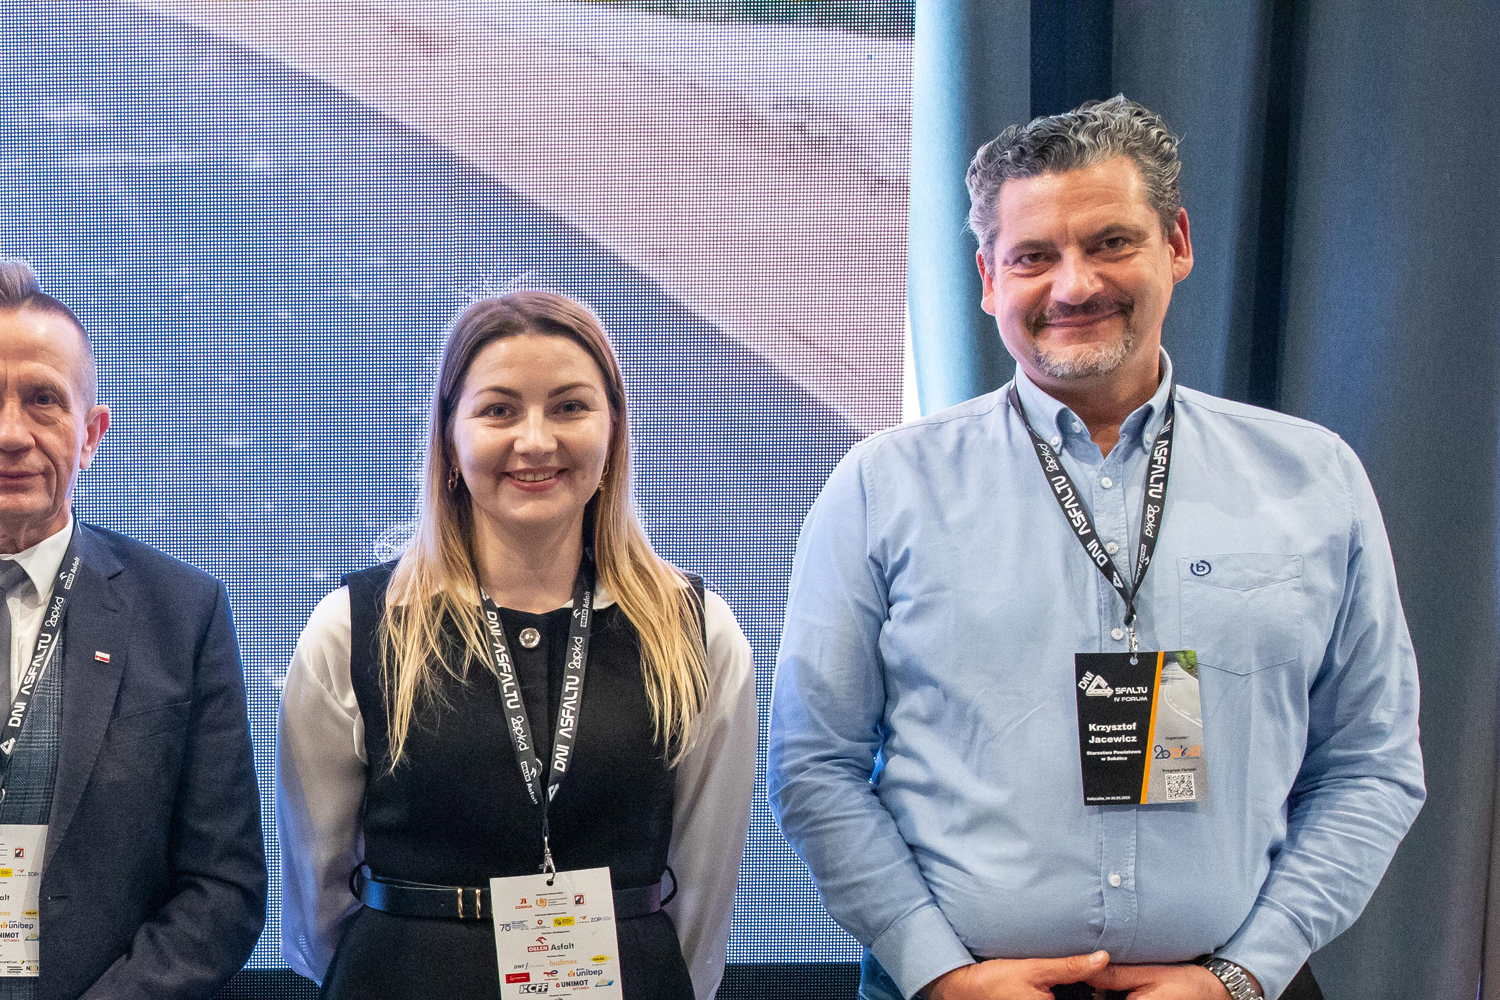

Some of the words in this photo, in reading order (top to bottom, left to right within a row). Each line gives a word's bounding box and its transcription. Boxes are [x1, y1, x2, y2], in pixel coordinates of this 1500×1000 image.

[1149, 439, 1169, 498] ASFALTU
[1051, 475, 1091, 536] ASFALTU
[1086, 538, 1108, 567] DNI
[486, 610, 502, 637] DNI
[8, 701, 27, 728] DNI
[20, 633, 52, 696] ASFALTU
[493, 642, 520, 710] ASFALTU
[1078, 671, 1095, 690] DNI
[1115, 686, 1148, 694] SFALTU
[560, 675, 580, 739] ASFALTU
[1088, 722, 1137, 733] Krzysztof
[1088, 735, 1137, 744] Jacewicz
[553, 744, 570, 773] DNI
[551, 942, 574, 951] Asfalt
[561, 980, 589, 988] UNIMOT
[576, 968, 603, 977] unibep
